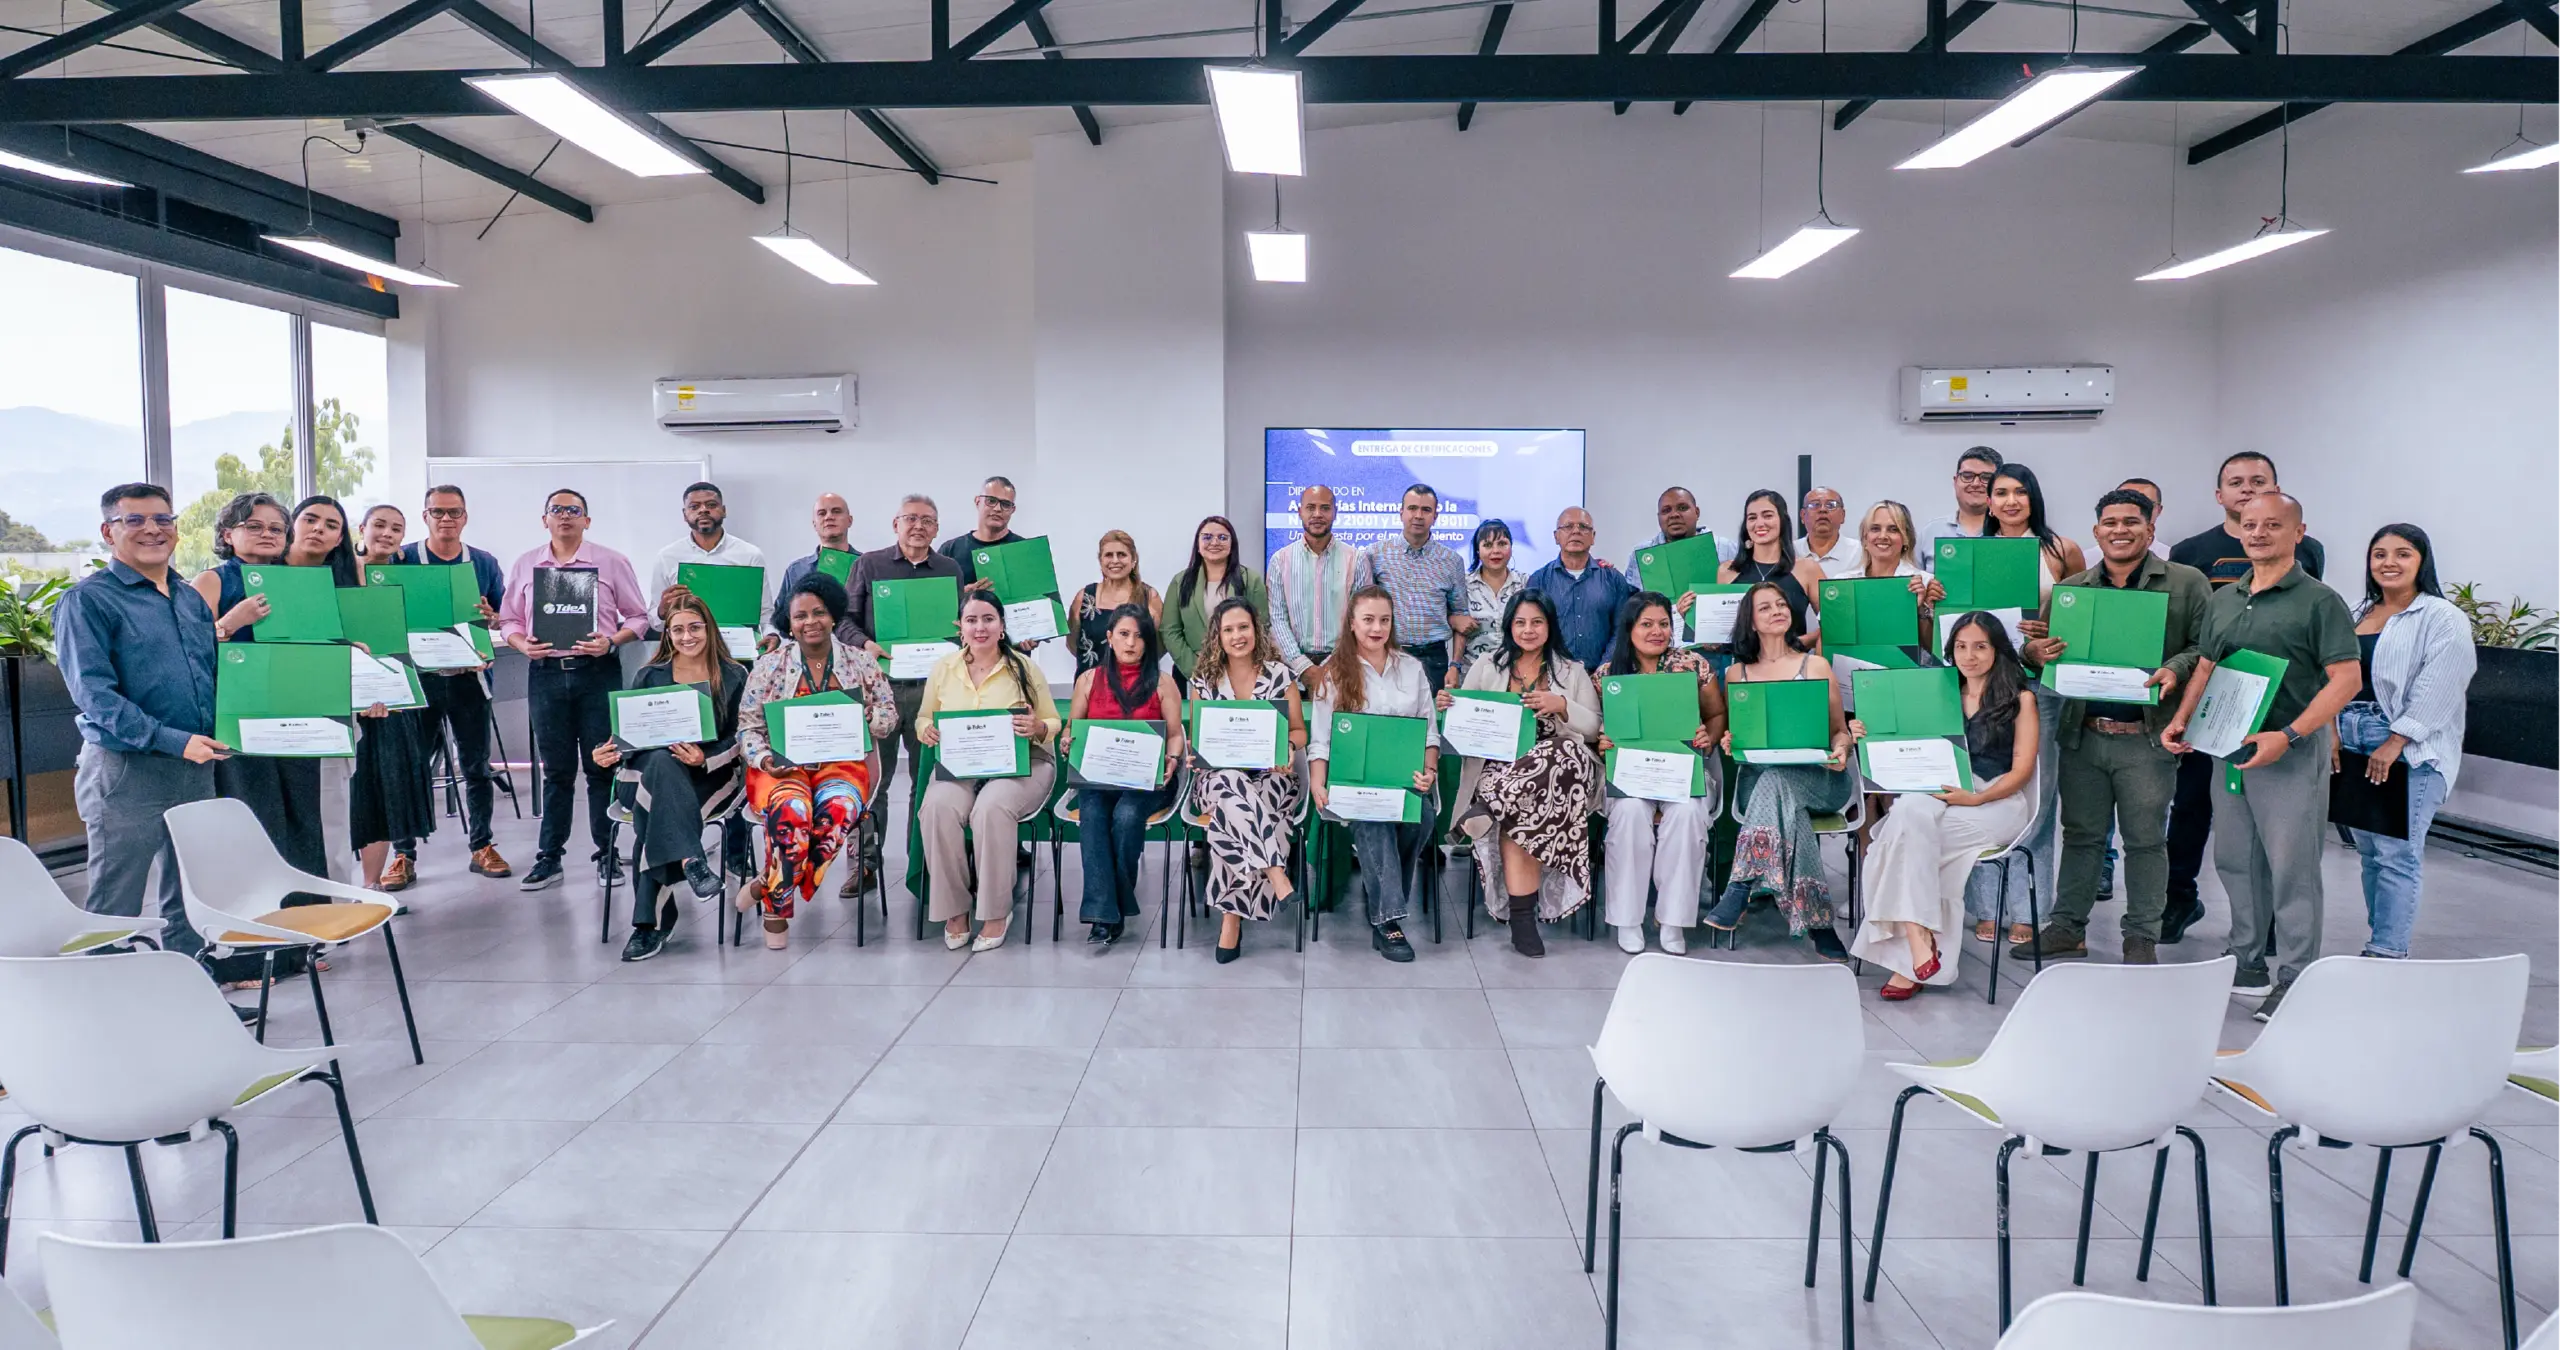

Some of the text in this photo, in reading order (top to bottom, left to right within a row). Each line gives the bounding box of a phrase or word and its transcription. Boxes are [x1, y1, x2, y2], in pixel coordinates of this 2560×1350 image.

[1357, 444, 1493, 454] ENTREGA DE CERTIFICACIONES
[1352, 486, 1365, 496] EN
[1445, 500, 1457, 512] la
[1343, 515, 1378, 526] 21001
[1355, 532, 1374, 543] por
[555, 603, 587, 613] TdeA
